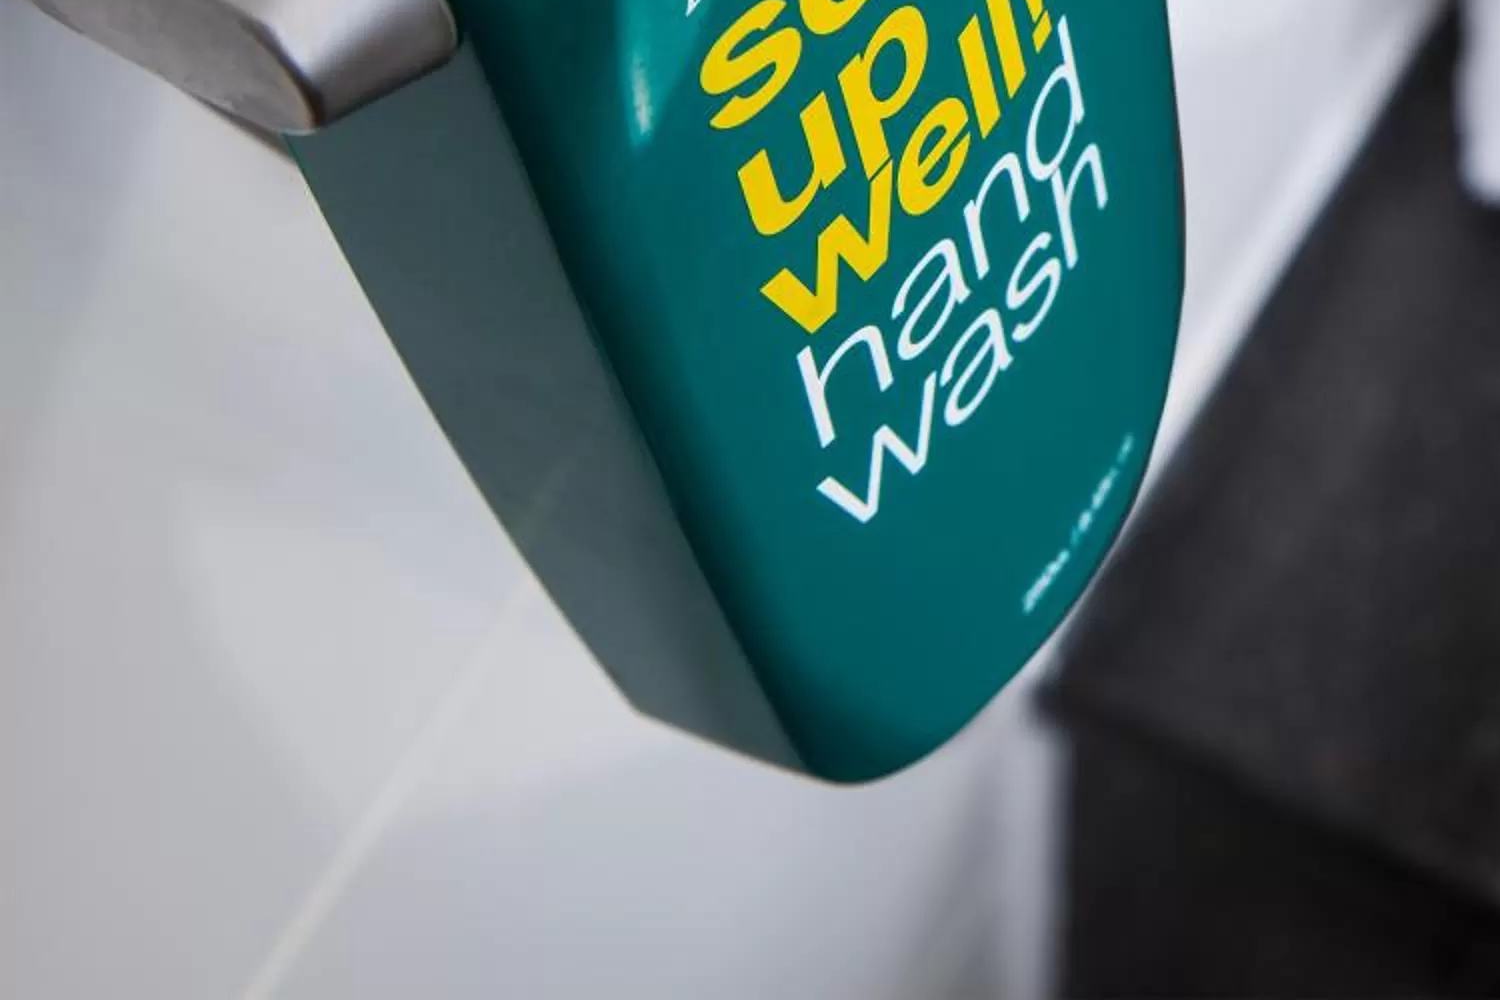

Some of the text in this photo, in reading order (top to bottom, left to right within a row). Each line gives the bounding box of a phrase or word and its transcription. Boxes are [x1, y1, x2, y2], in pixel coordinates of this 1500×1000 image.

[737, 5, 929, 236] up
[796, 15, 1086, 448] hand
[817, 142, 1108, 524] wash
